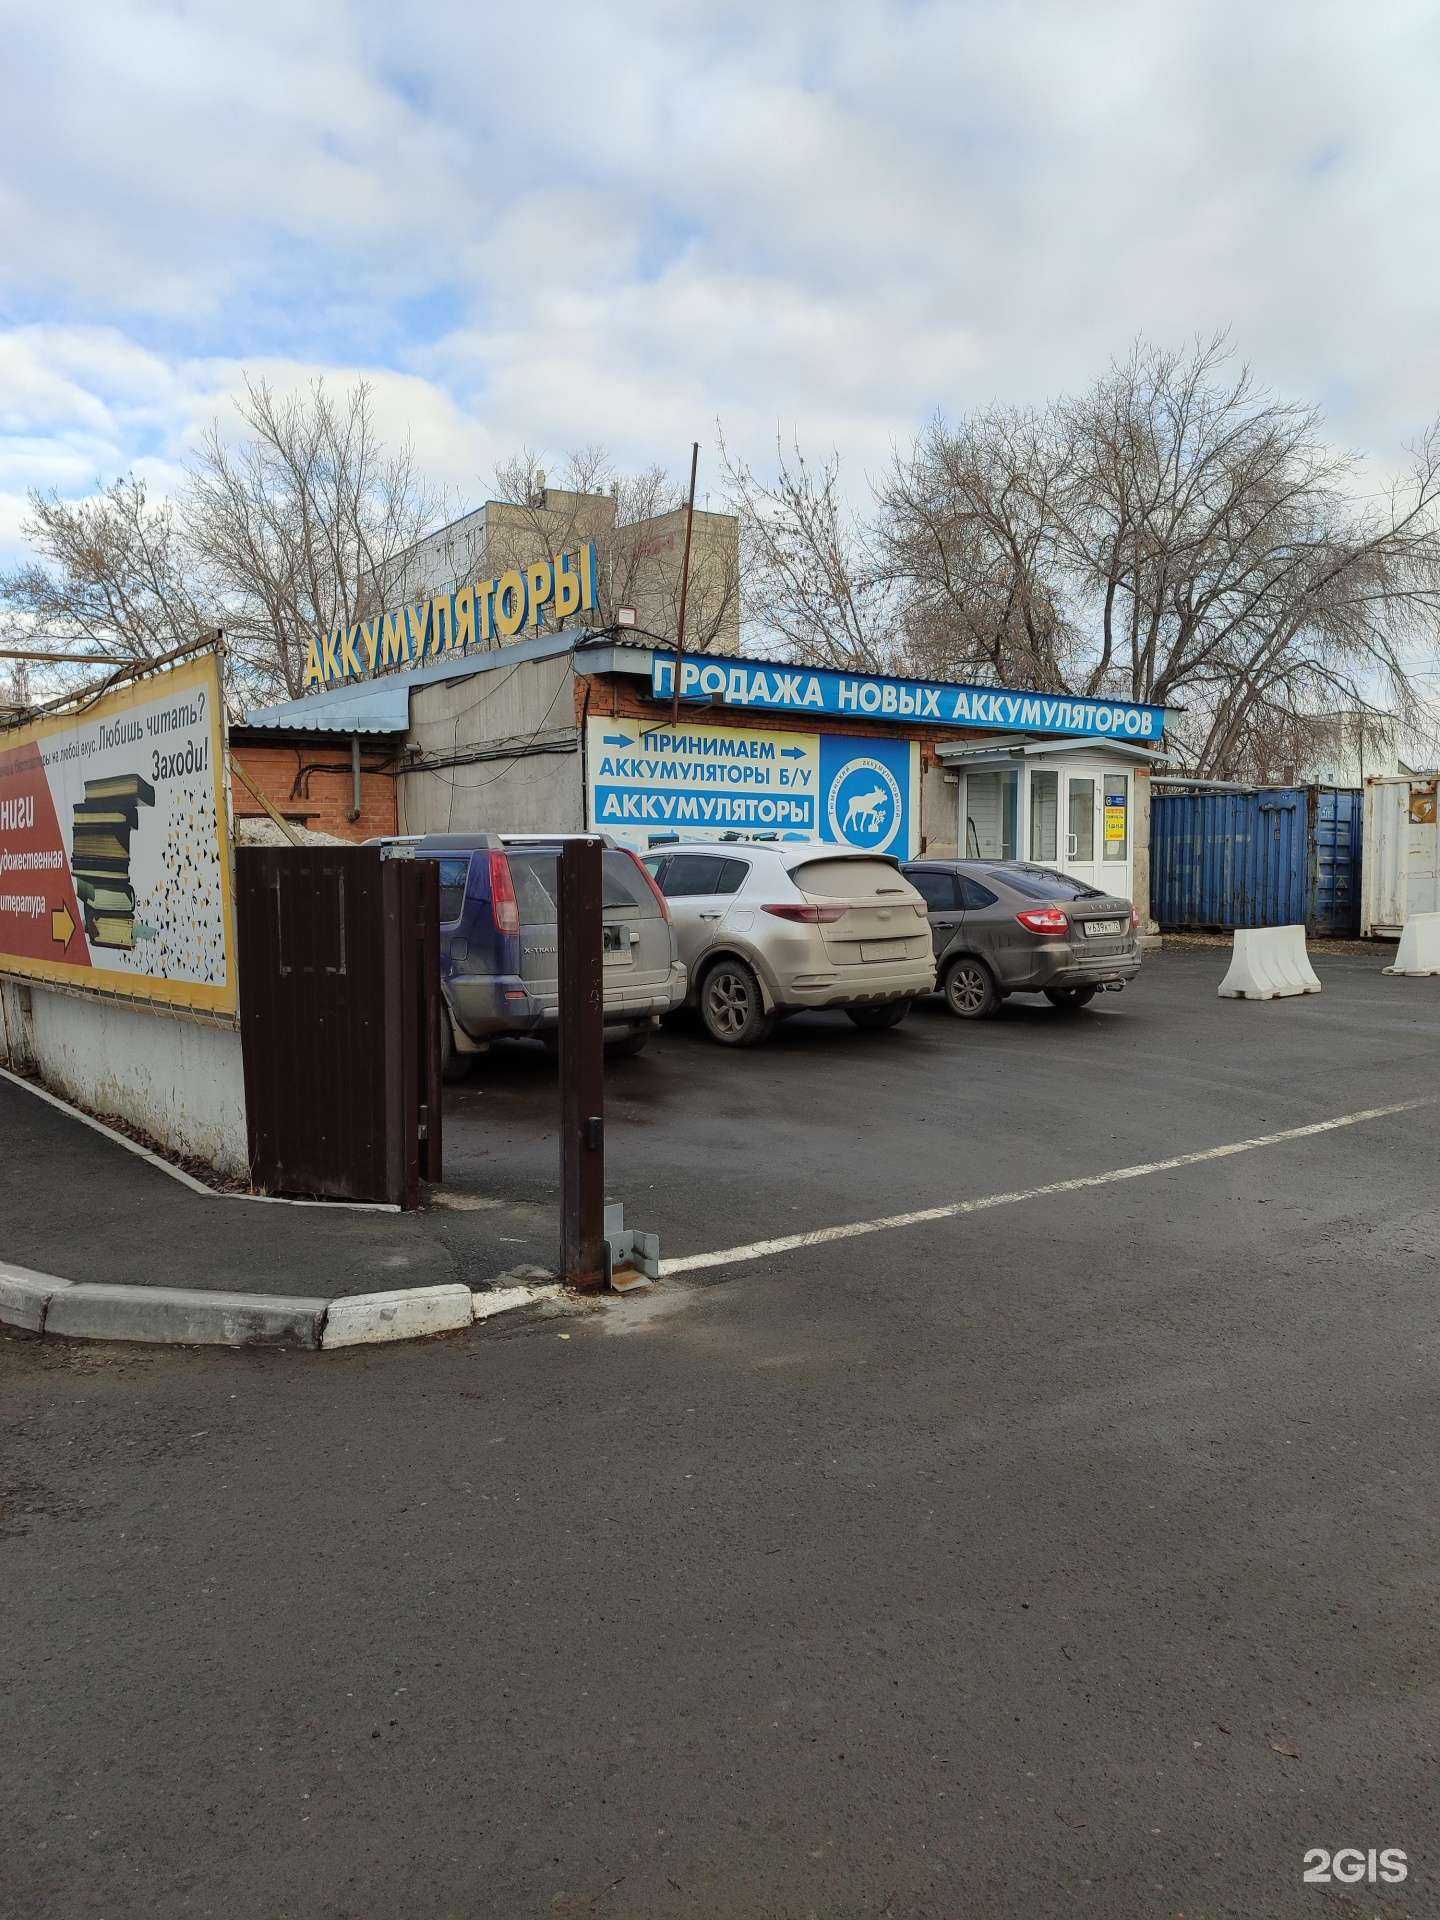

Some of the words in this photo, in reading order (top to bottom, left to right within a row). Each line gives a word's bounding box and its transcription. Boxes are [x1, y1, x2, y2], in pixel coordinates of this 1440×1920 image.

[304, 543, 598, 686] АККУМУЛЯТОРЫ
[653, 659, 825, 708] ПРОДАЖА
[838, 679, 942, 718] НОВЫХ
[951, 692, 1153, 736] АККУМУЛЯТОРОВ
[99, 717, 144, 752] Любишь
[147, 691, 206, 737] читать?
[151, 736, 209, 782] Заходи!
[643, 733, 776, 760] ПРИНИМАЕМ
[599, 757, 770, 786] АККУМУЛЯТОРЫ
[779, 767, 812, 789] Б/У
[602, 792, 810, 824] АККУМУЛЯТОРЫ
